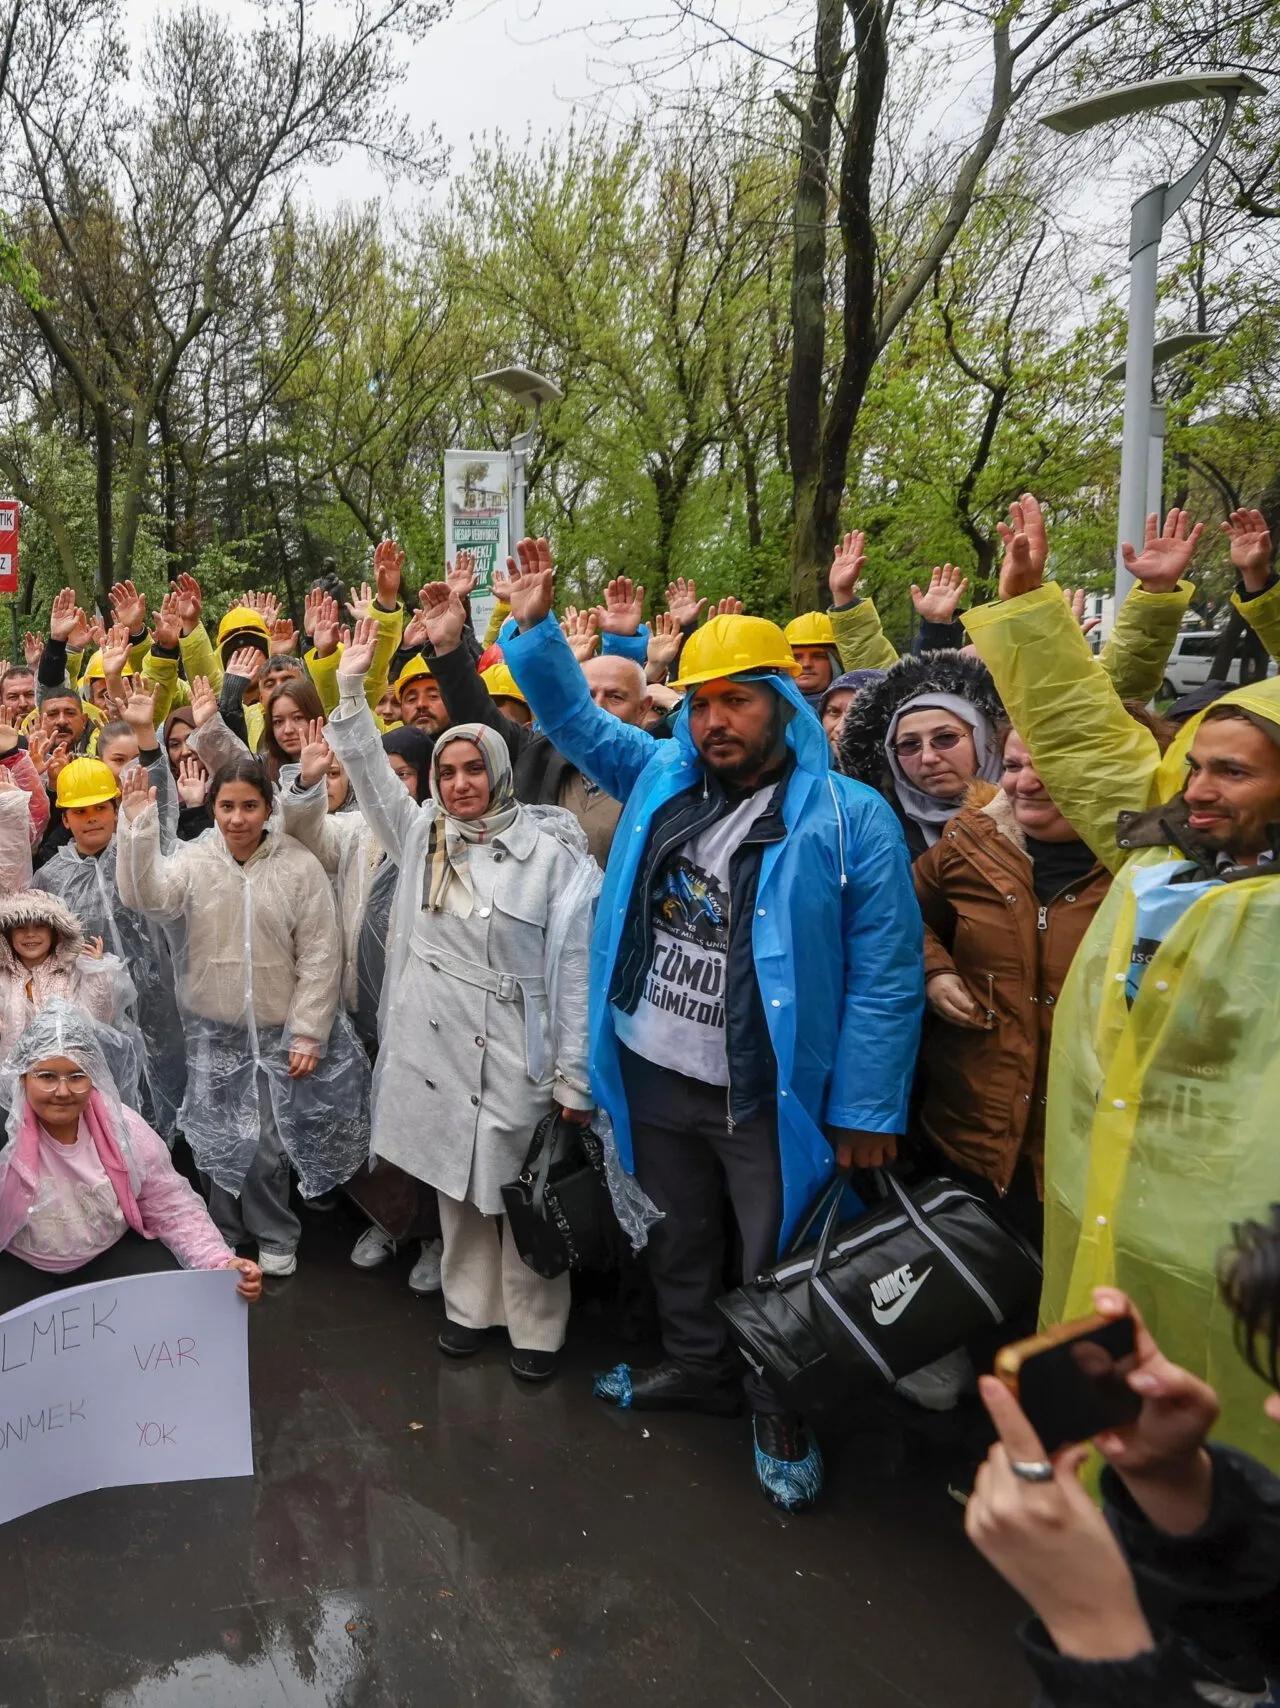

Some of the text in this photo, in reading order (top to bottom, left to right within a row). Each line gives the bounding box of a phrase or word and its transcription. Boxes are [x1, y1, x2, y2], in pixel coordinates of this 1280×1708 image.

[869, 1263, 916, 1308] NIKE
[132, 1336, 200, 1372] VAR
[135, 1421, 178, 1447] YOK
